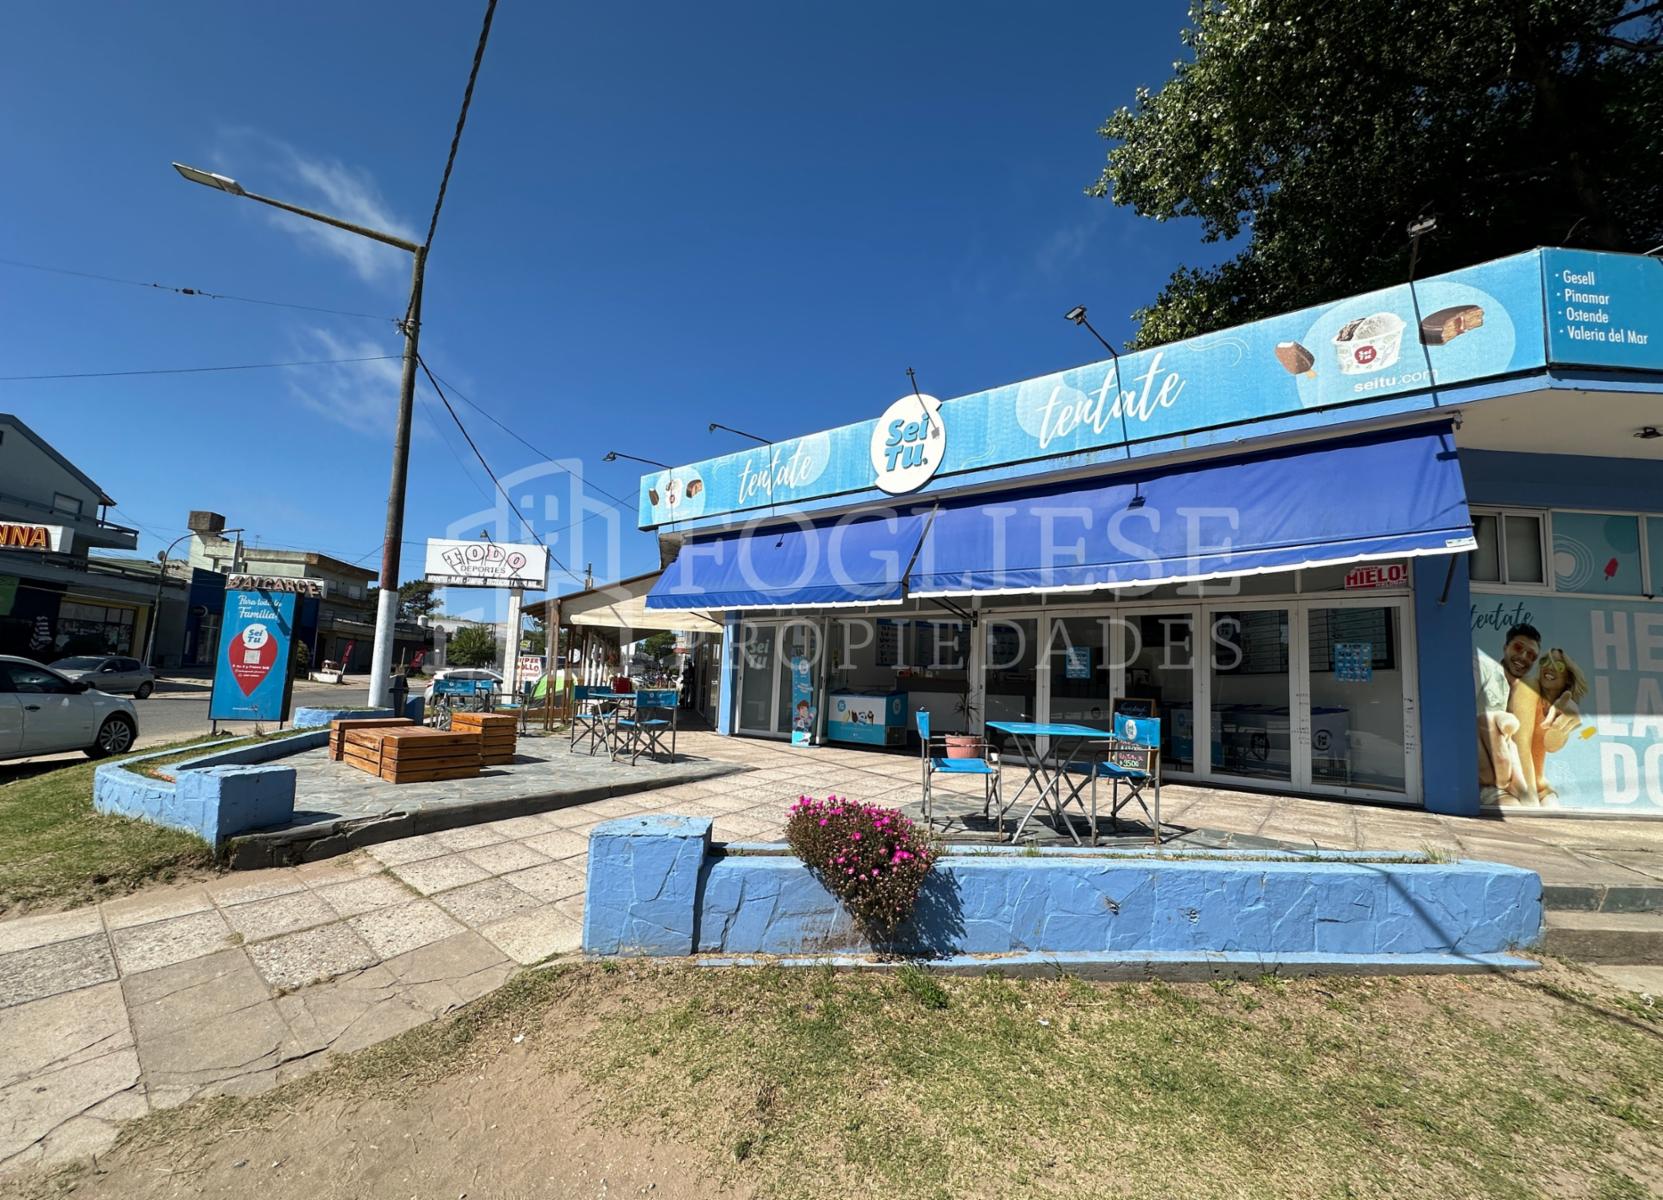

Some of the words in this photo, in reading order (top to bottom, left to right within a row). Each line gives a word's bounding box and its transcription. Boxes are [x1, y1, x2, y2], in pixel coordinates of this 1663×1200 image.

[1563, 270, 1595, 286] Gesell
[1565, 288, 1610, 305] Pinamar
[1566, 306, 1609, 323] Ostende
[1567, 325, 1606, 342] Valeria
[1608, 327, 1625, 343] del
[1627, 330, 1649, 345] Mar
[1353, 368, 1439, 393] seitu.com
[1036, 351, 1186, 450] tentate
[885, 413, 930, 447] Sei
[737, 438, 814, 505] tentate
[442, 544, 527, 571] TODO
[460, 565, 506, 574] DEPORTES
[1345, 565, 1409, 587] HIELO!
[1470, 601, 1534, 631] tentate
[248, 627, 263, 636] Sei
